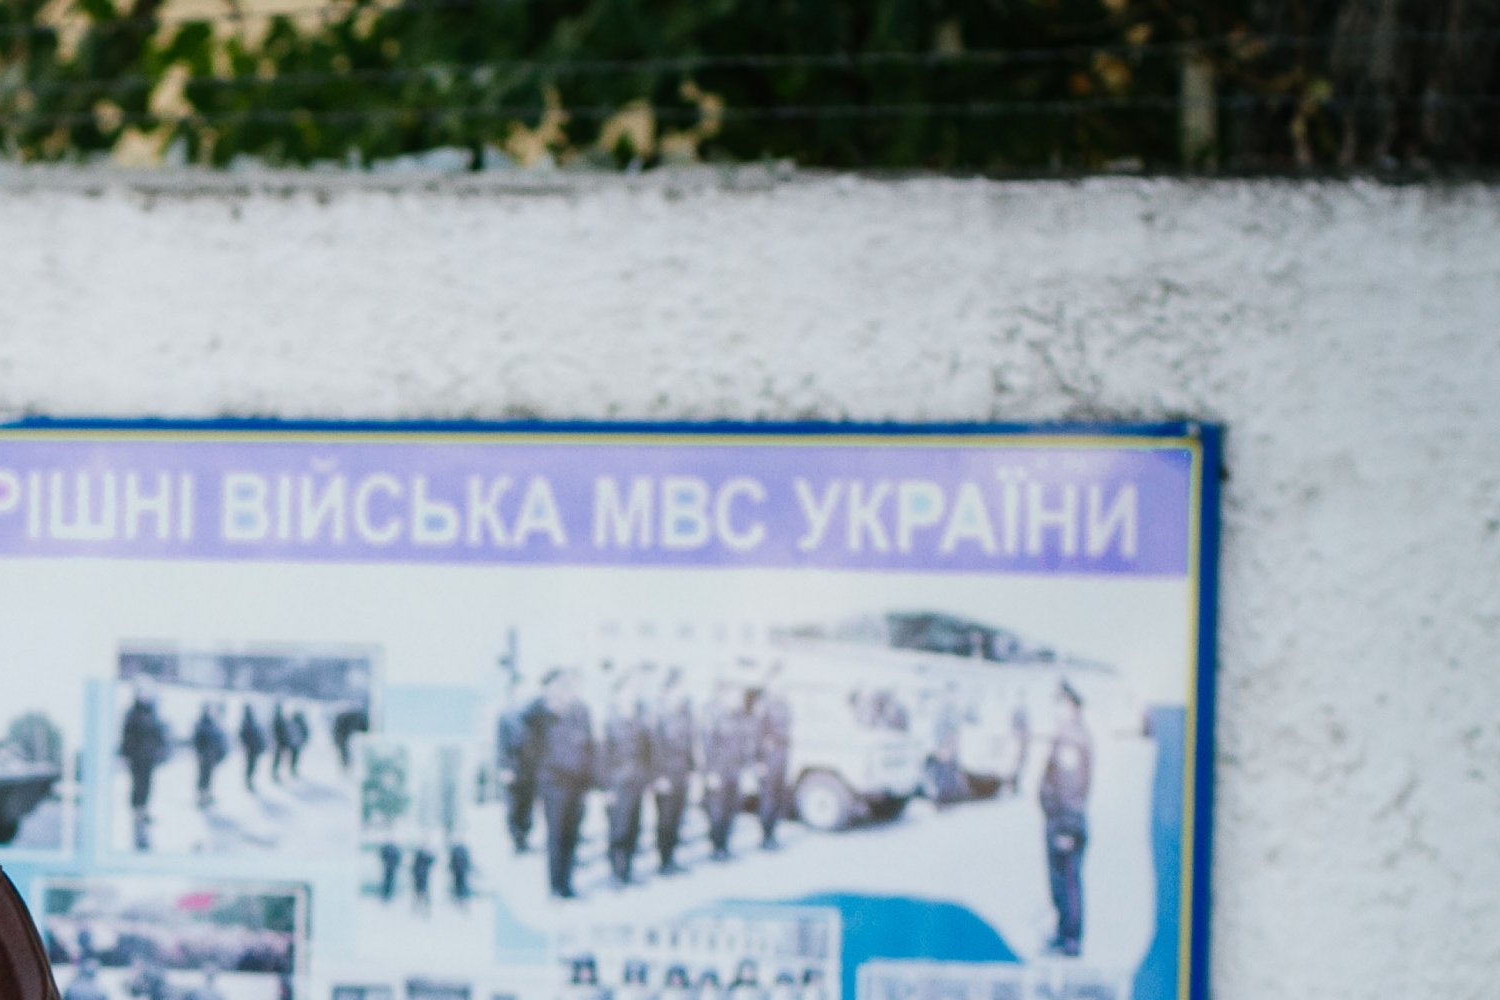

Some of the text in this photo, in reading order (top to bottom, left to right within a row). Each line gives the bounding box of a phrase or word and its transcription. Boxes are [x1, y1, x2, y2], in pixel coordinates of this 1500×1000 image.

[221, 460, 566, 548] ВІЙСЬКА
[591, 474, 768, 550] МВС
[793, 464, 1140, 558] УКРАЇНИ
